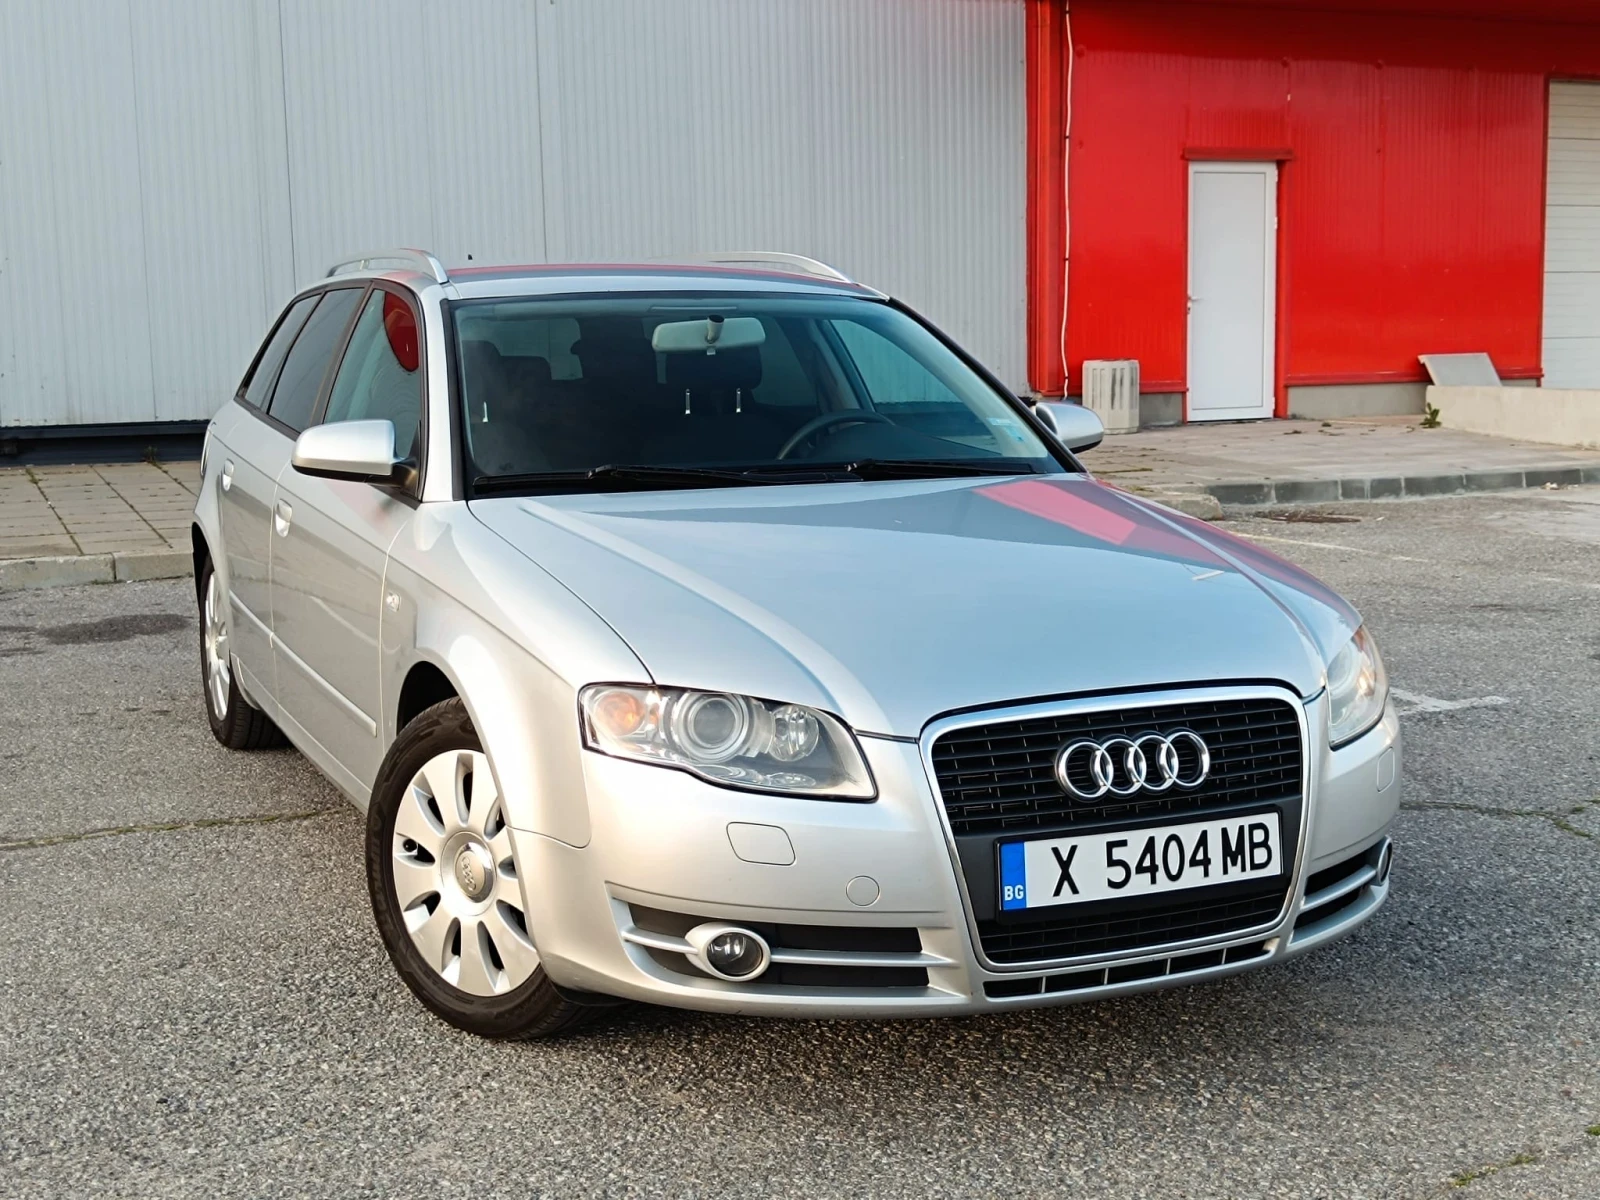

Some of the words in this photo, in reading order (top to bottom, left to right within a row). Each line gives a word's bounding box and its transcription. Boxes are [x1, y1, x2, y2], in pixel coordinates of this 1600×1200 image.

[1051, 844, 1080, 898] X
[1105, 829, 1212, 890] 5404
[1220, 822, 1273, 876] MB
[1004, 884, 1025, 901] BG
